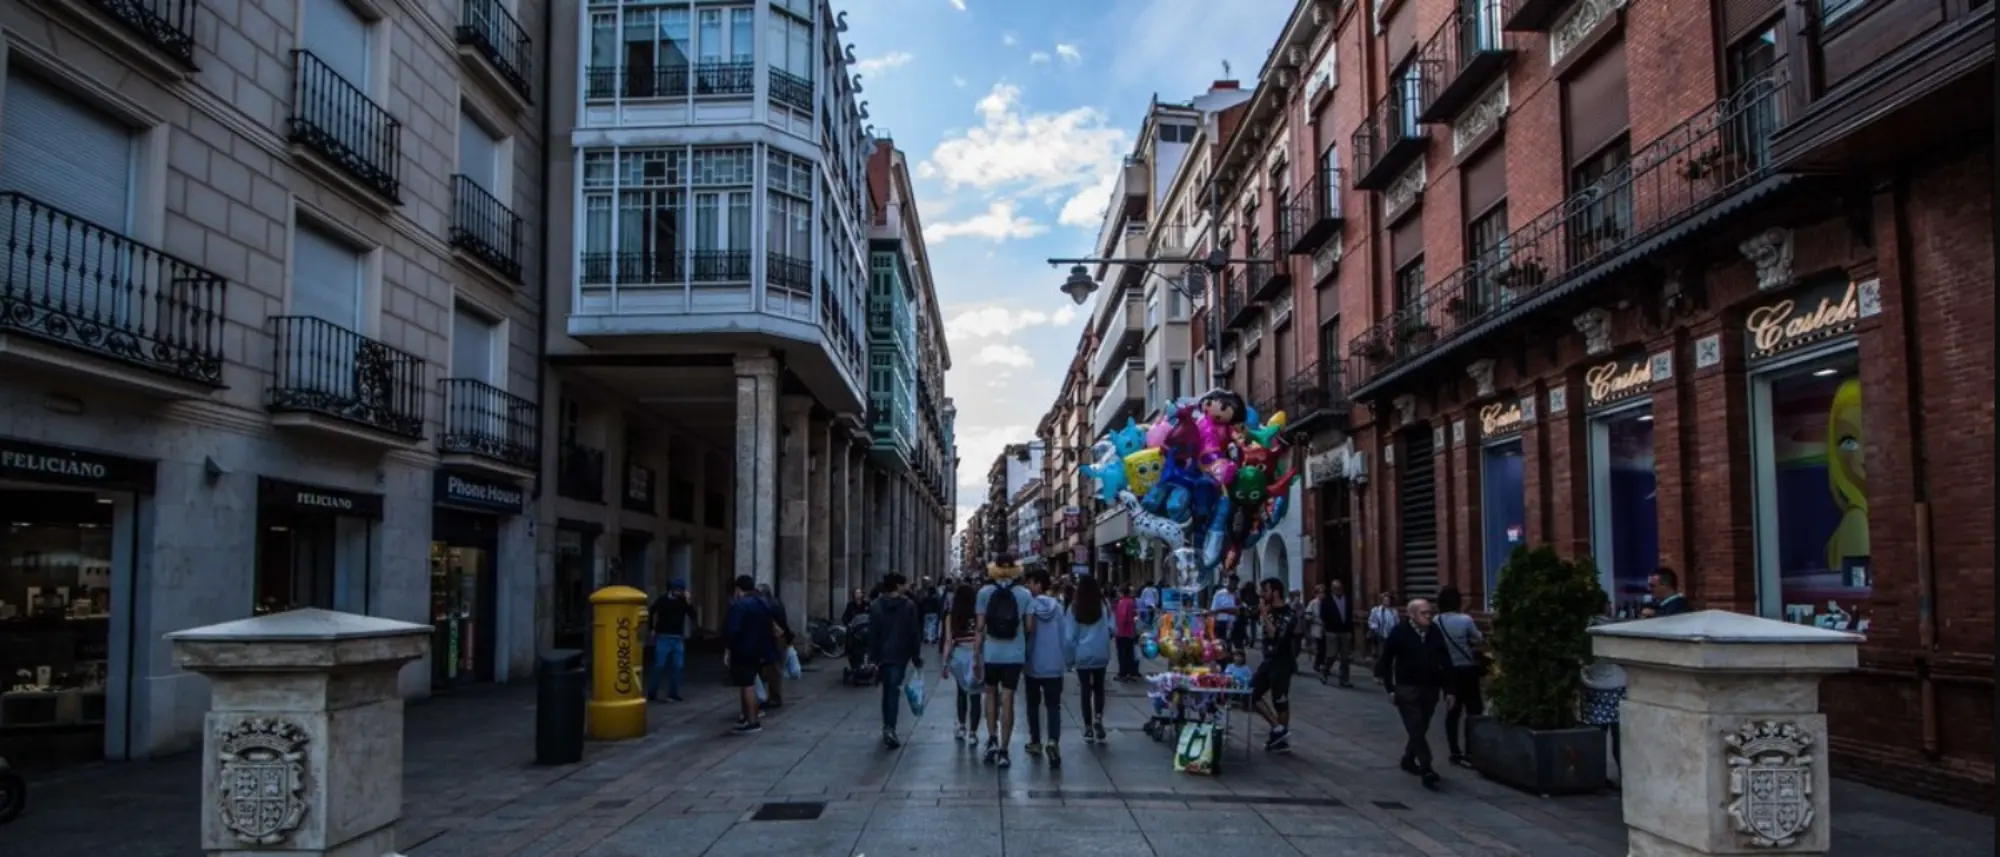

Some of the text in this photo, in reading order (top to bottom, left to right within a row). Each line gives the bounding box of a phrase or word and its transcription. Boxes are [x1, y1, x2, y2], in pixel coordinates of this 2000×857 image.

[1, 450, 106, 477] FELICIANO
[448, 476, 486, 499] Phone
[297, 492, 352, 509] FELICIANO
